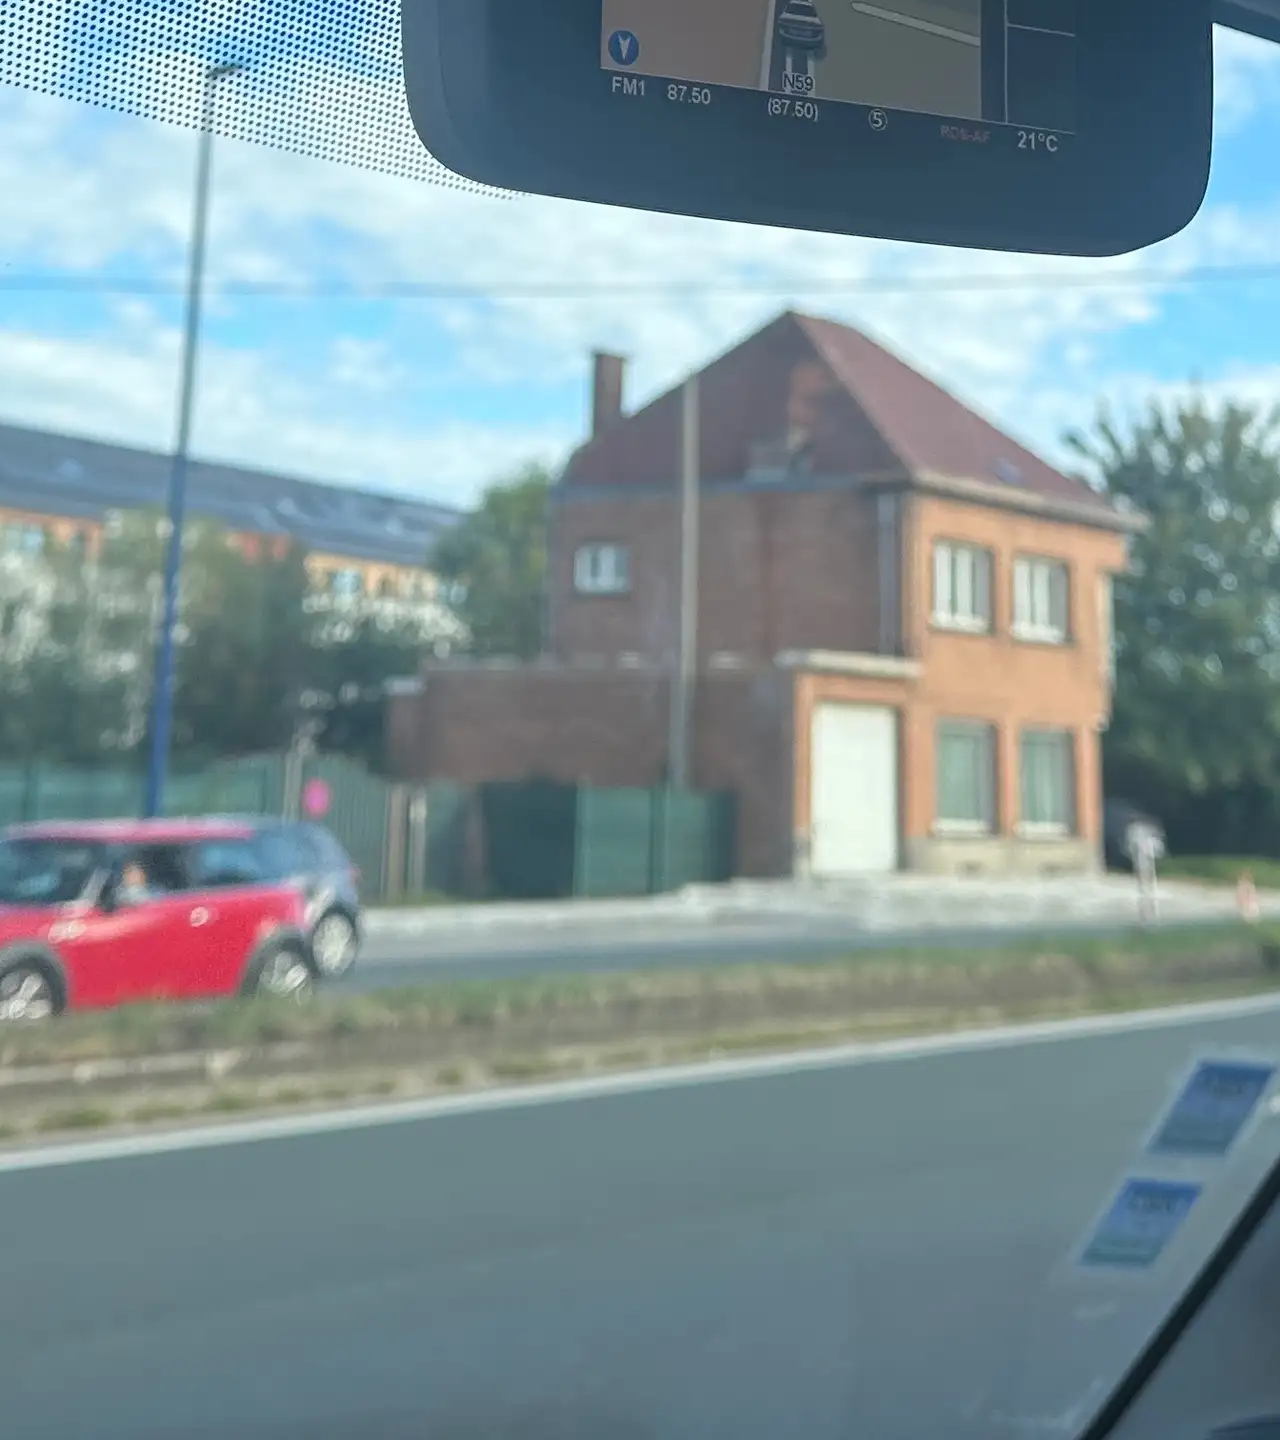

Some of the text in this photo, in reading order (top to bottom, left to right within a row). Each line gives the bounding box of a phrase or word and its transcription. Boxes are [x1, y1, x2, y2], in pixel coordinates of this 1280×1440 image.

[782, 72, 814, 93] N59
[611, 76, 646, 96] FM1
[667, 84, 711, 105] 87.50
[767, 97, 819, 122] (87.50)
[1017, 131, 1058, 152] 21°C
